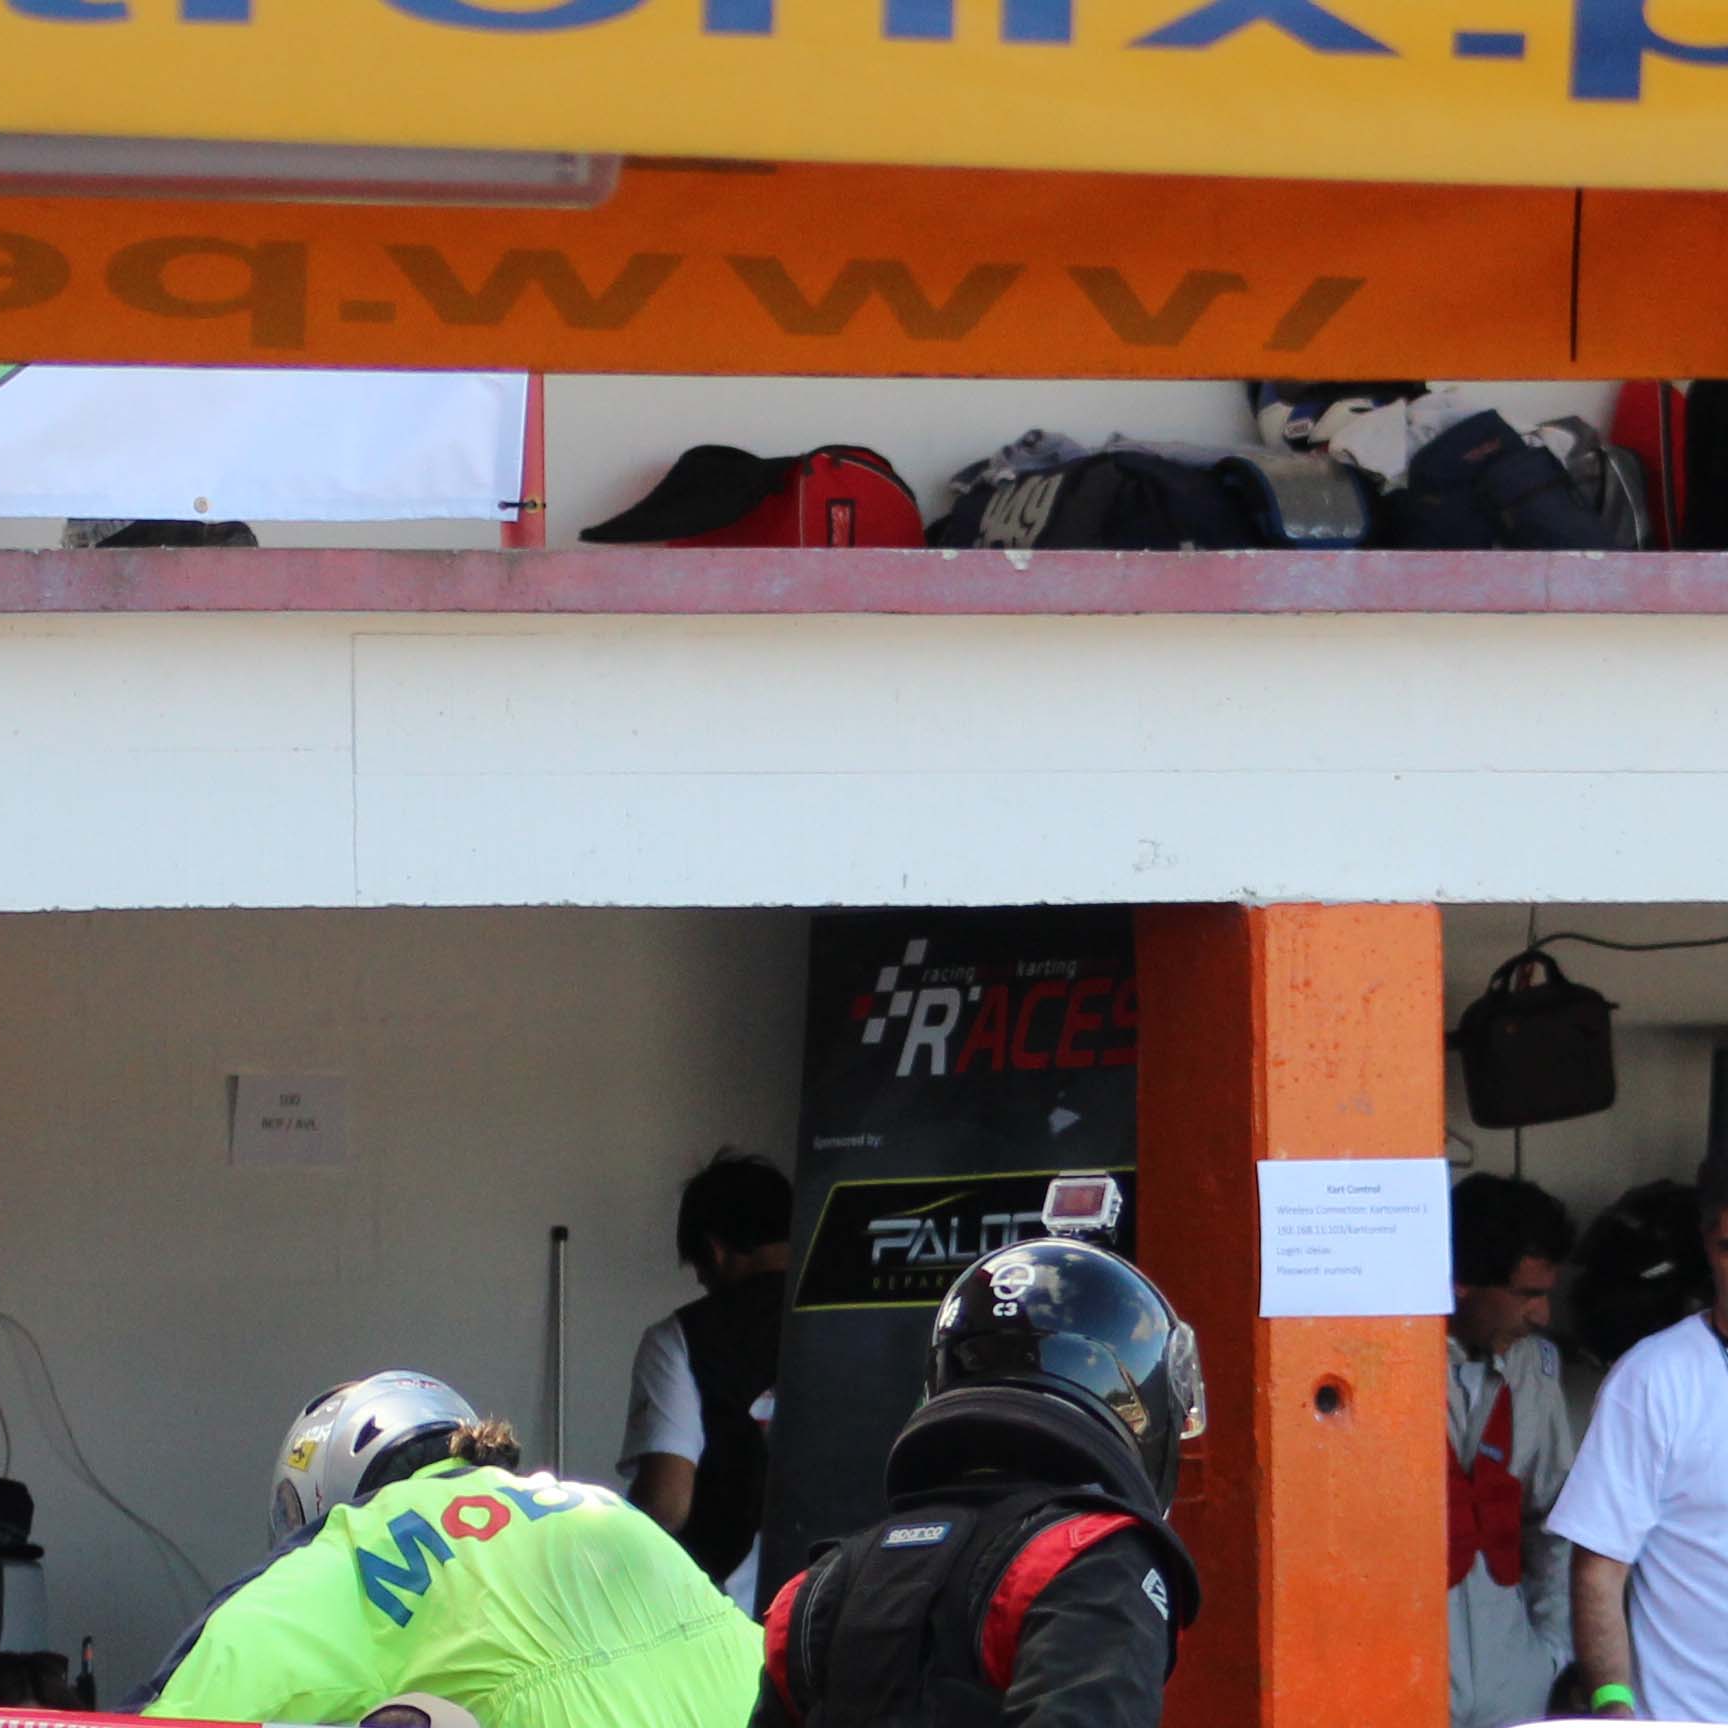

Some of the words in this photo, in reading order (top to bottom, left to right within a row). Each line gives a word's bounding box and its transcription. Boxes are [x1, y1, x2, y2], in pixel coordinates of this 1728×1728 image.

[922, 965, 976, 984] racing
[1016, 958, 1078, 979] karting
[867, 1211, 1044, 1265] PALO
